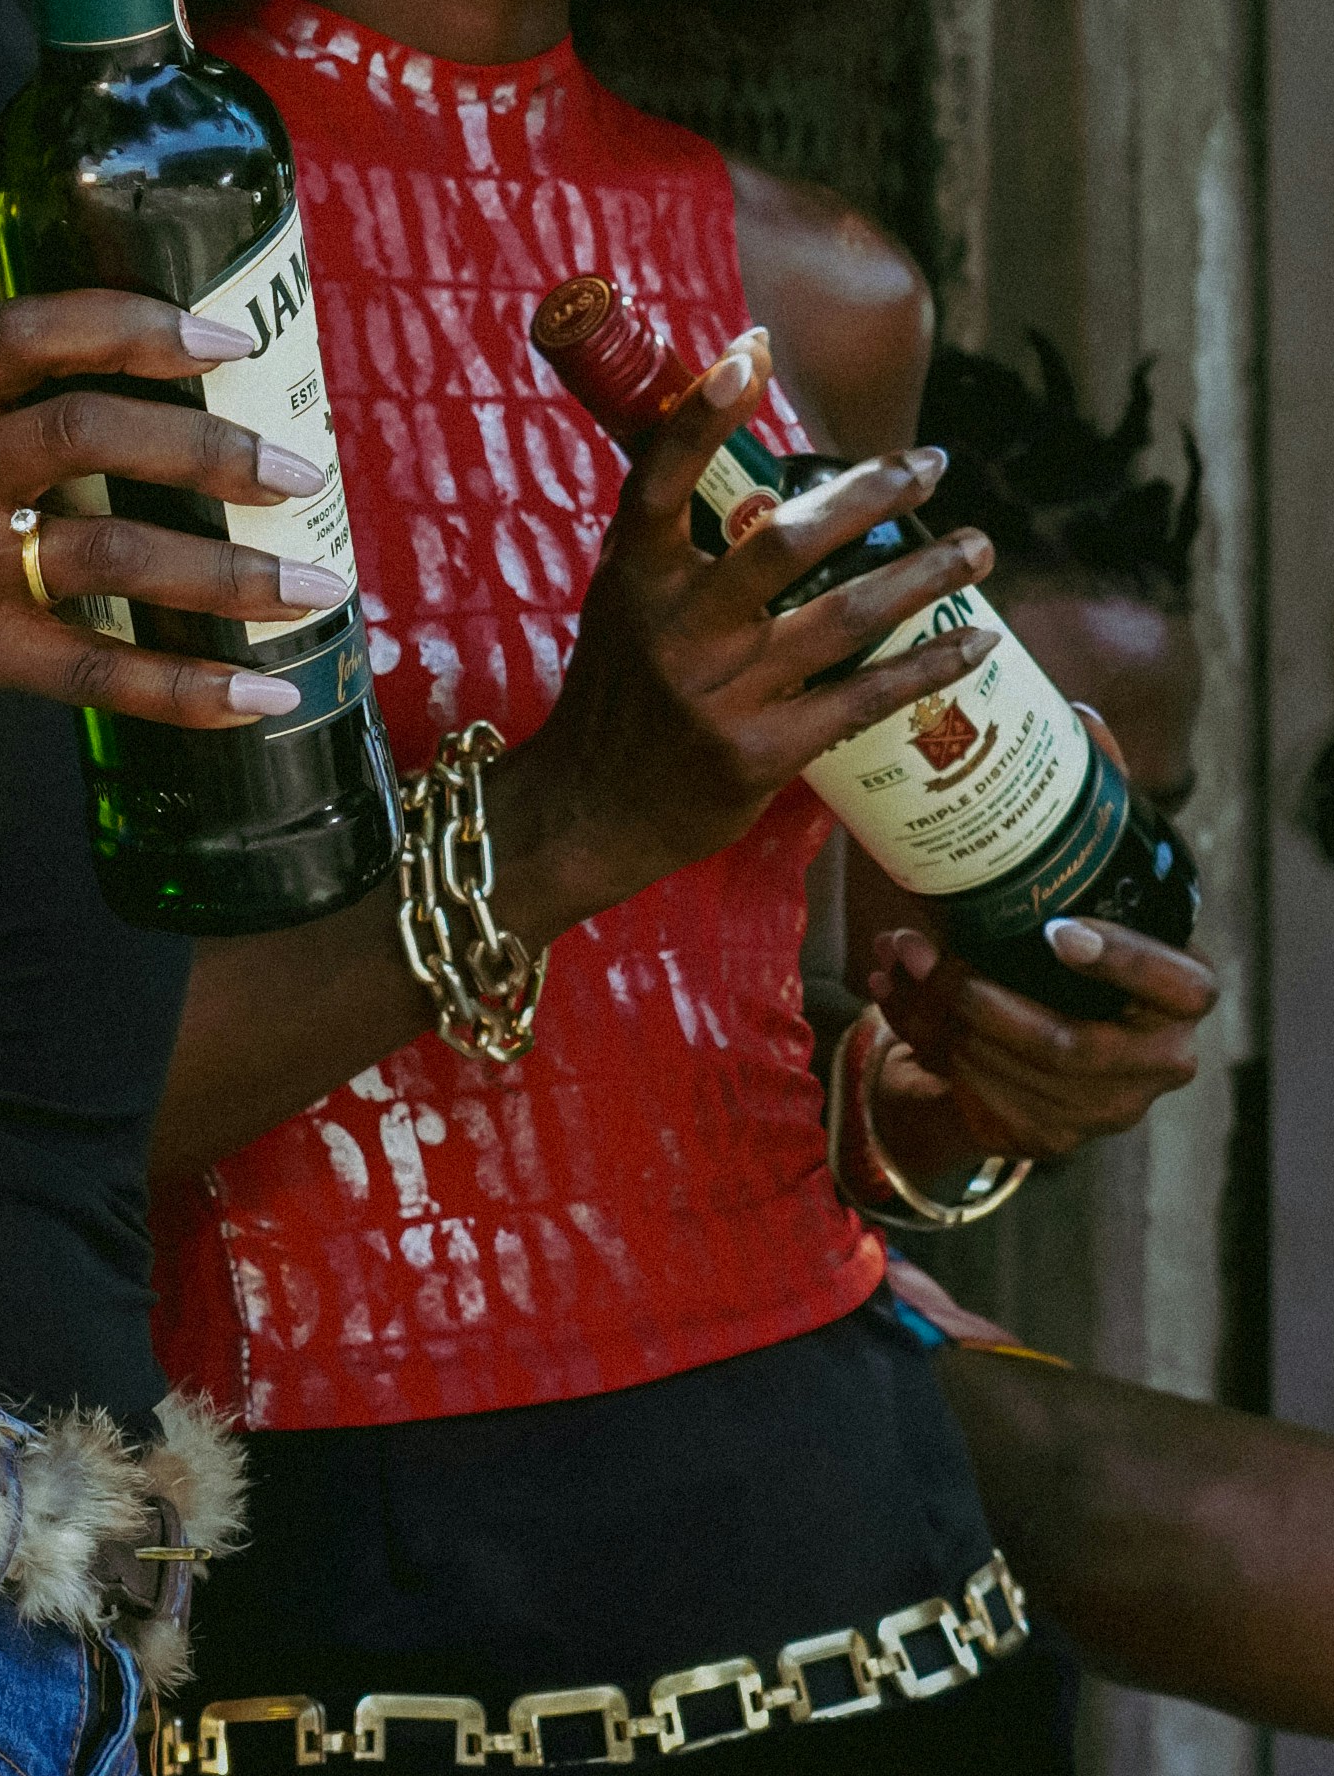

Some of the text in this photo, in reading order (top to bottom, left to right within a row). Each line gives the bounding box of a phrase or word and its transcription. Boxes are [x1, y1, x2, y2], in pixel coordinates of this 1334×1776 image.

[904, 710, 1037, 830] TRIPLE DISTILLED
[949, 829, 1000, 863] IRISH
[1000, 756, 1062, 831] WHISKEY
